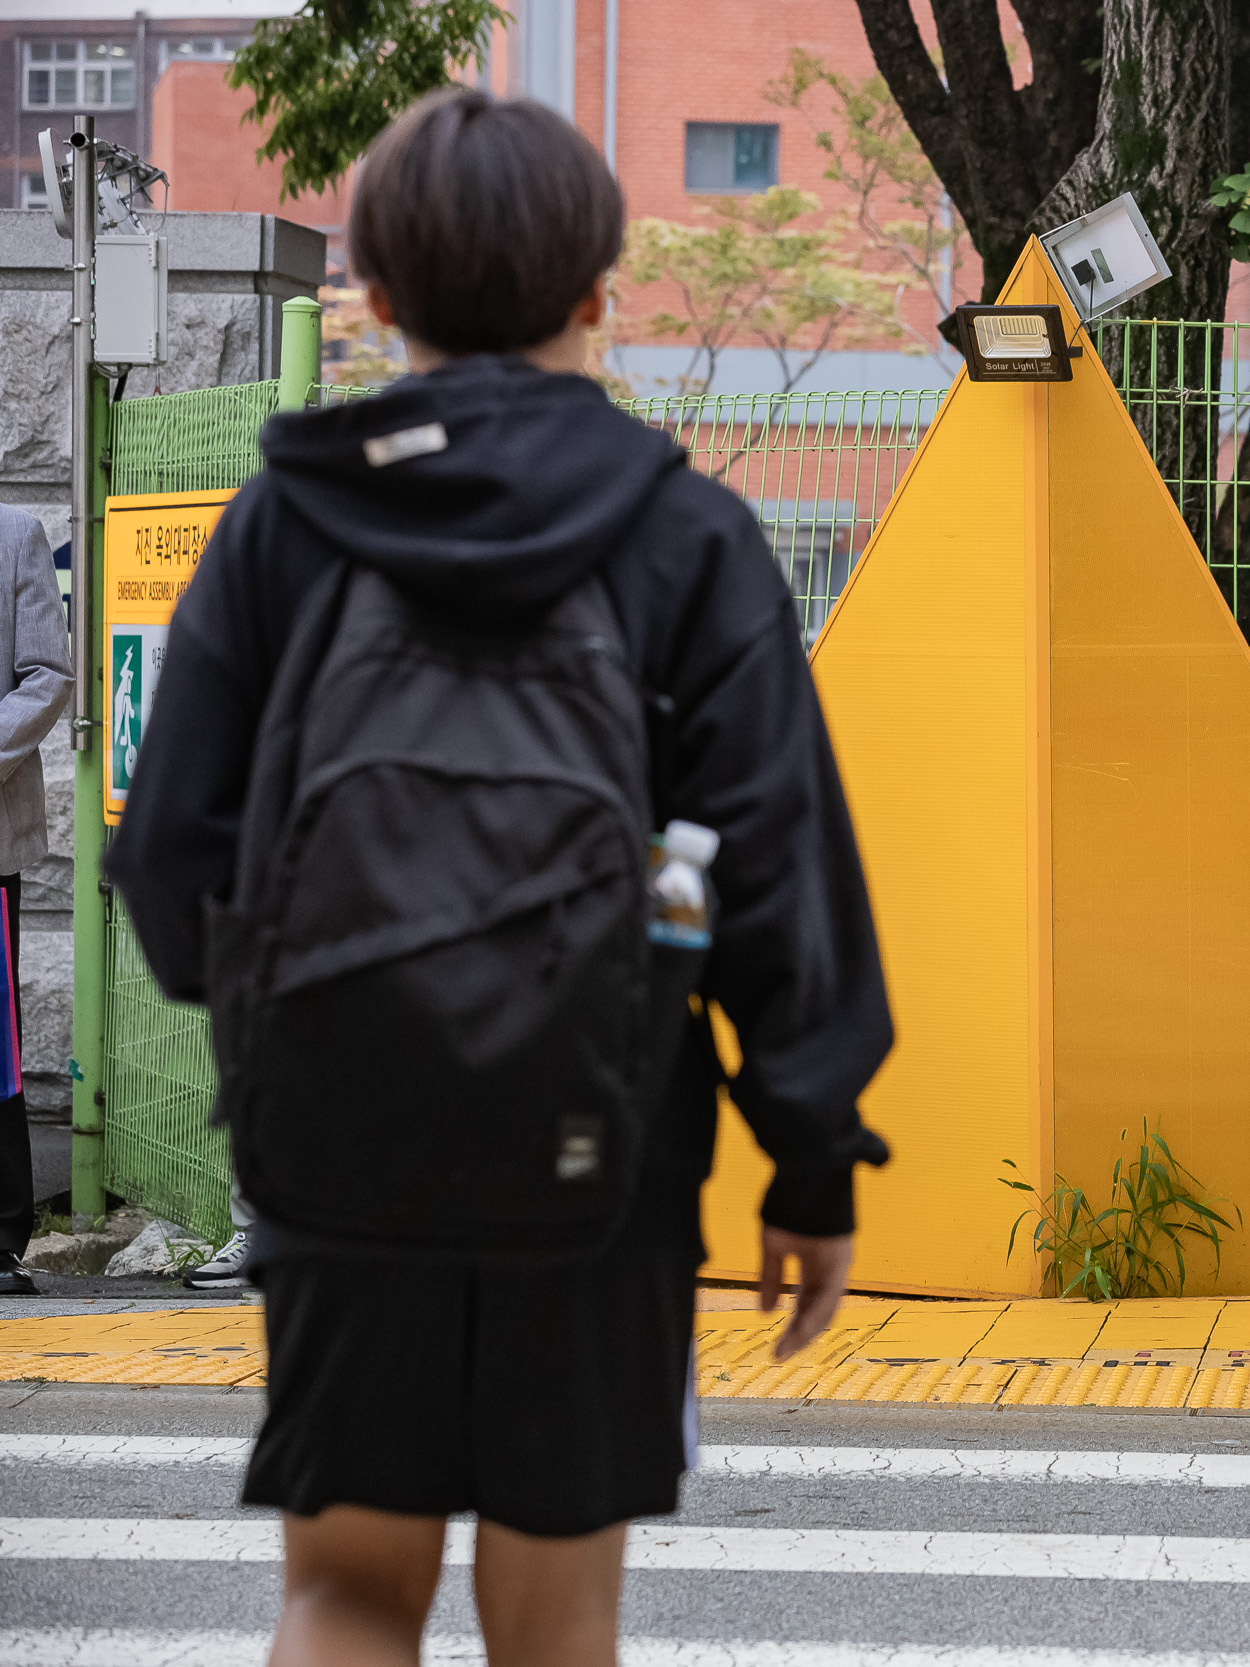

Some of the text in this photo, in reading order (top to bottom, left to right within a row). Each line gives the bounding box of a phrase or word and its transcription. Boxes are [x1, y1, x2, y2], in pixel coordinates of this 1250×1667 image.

[985, 362, 1009, 370] Solar
[1013, 362, 1035, 371] Light
[136, 525, 152, 566] 지진
[117, 580, 148, 601] EMERGENCY
[148, 580, 176, 601] ASSEMBLY
